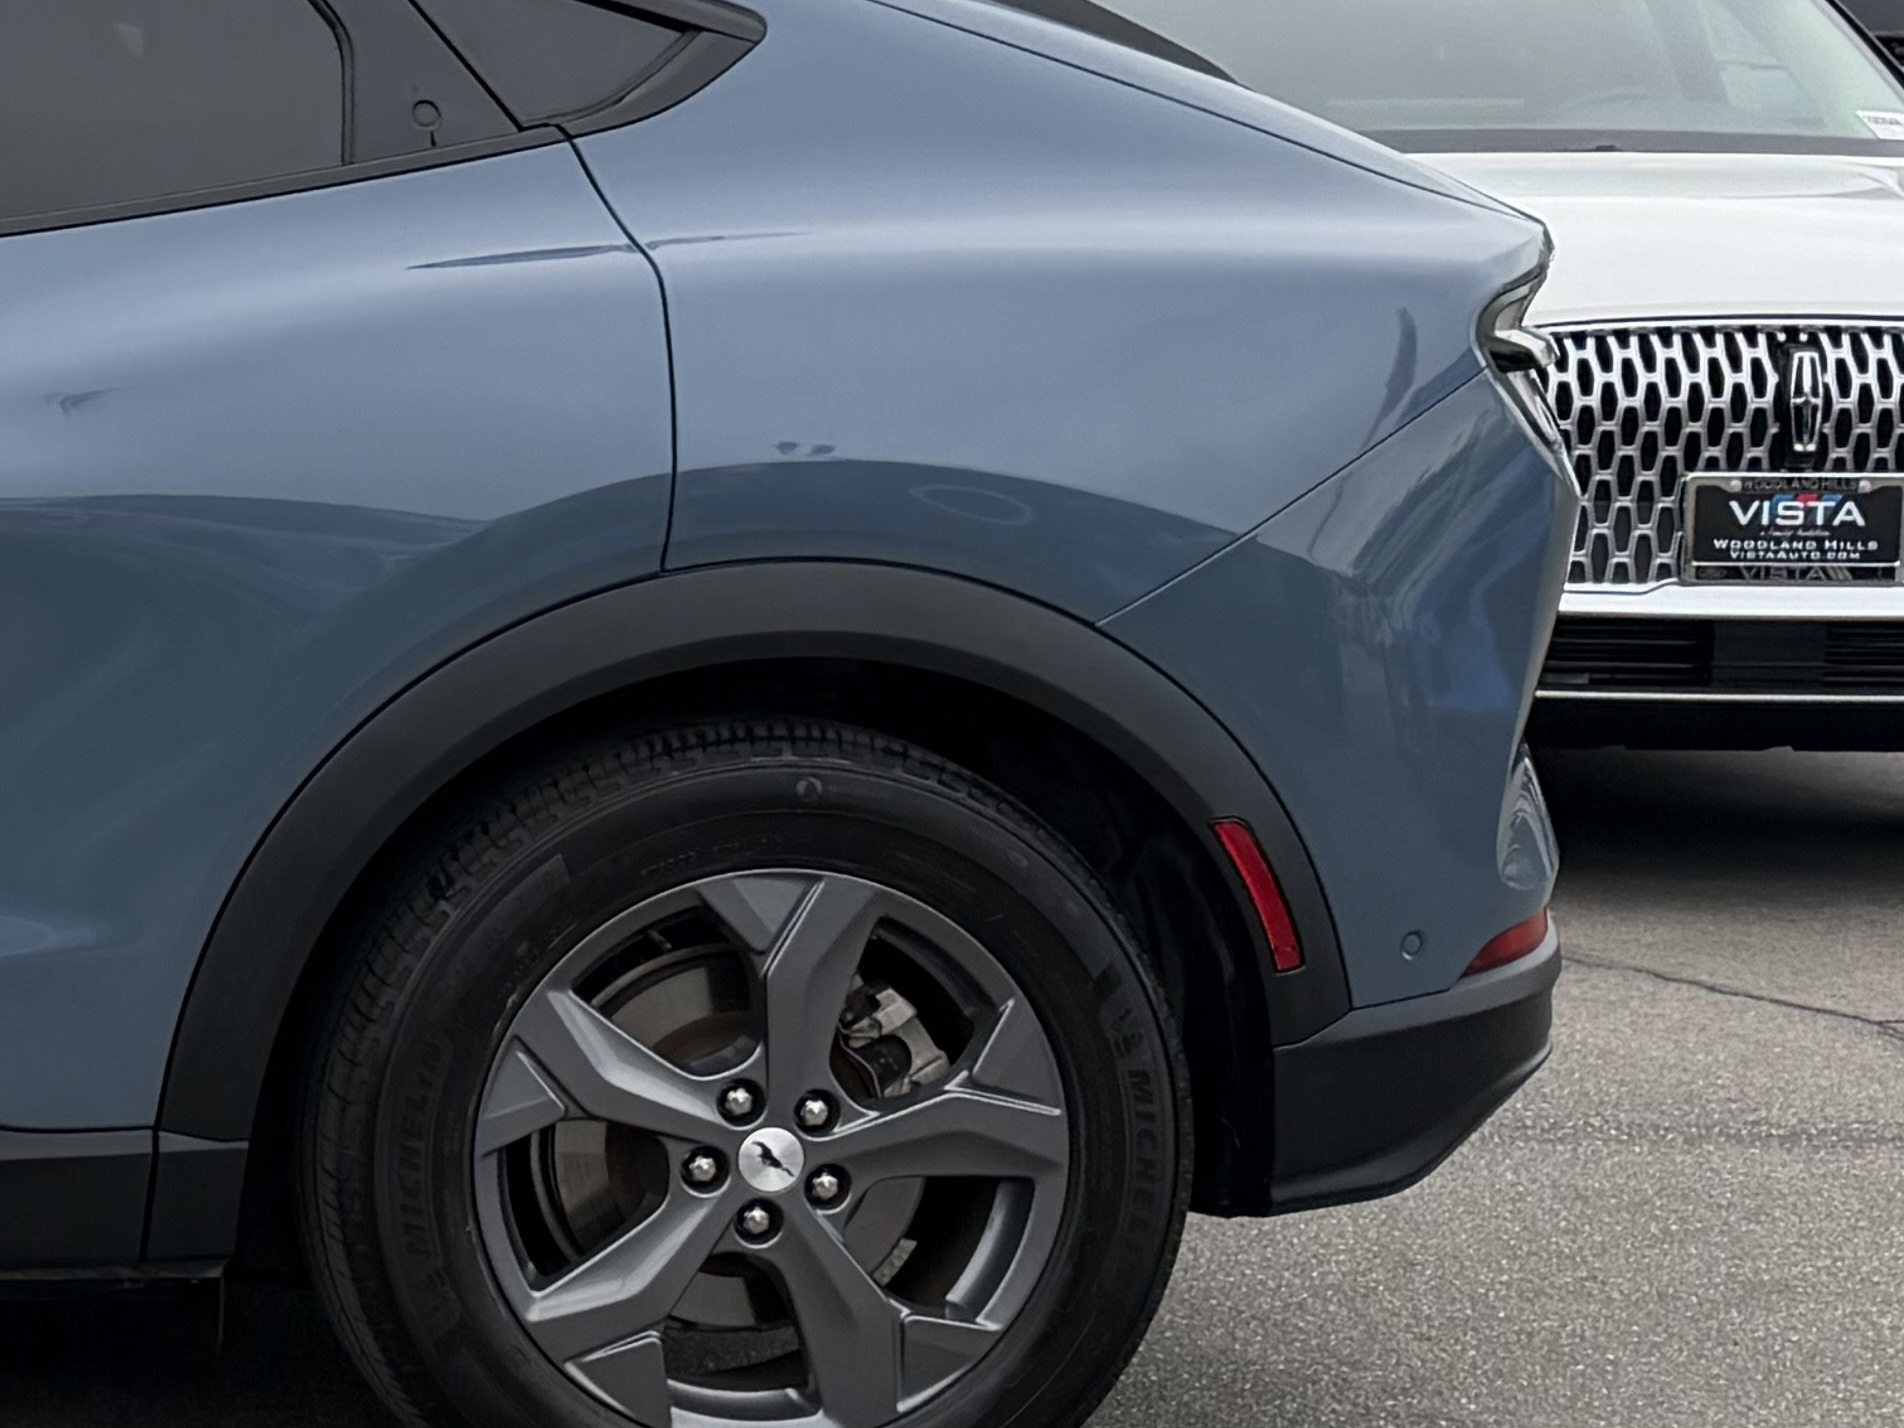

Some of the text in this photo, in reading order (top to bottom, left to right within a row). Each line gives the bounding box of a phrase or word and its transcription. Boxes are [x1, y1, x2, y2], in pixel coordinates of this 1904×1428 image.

[1728, 499, 1867, 527] VISTA
[1713, 538, 1879, 551] WOODLAND HILLS
